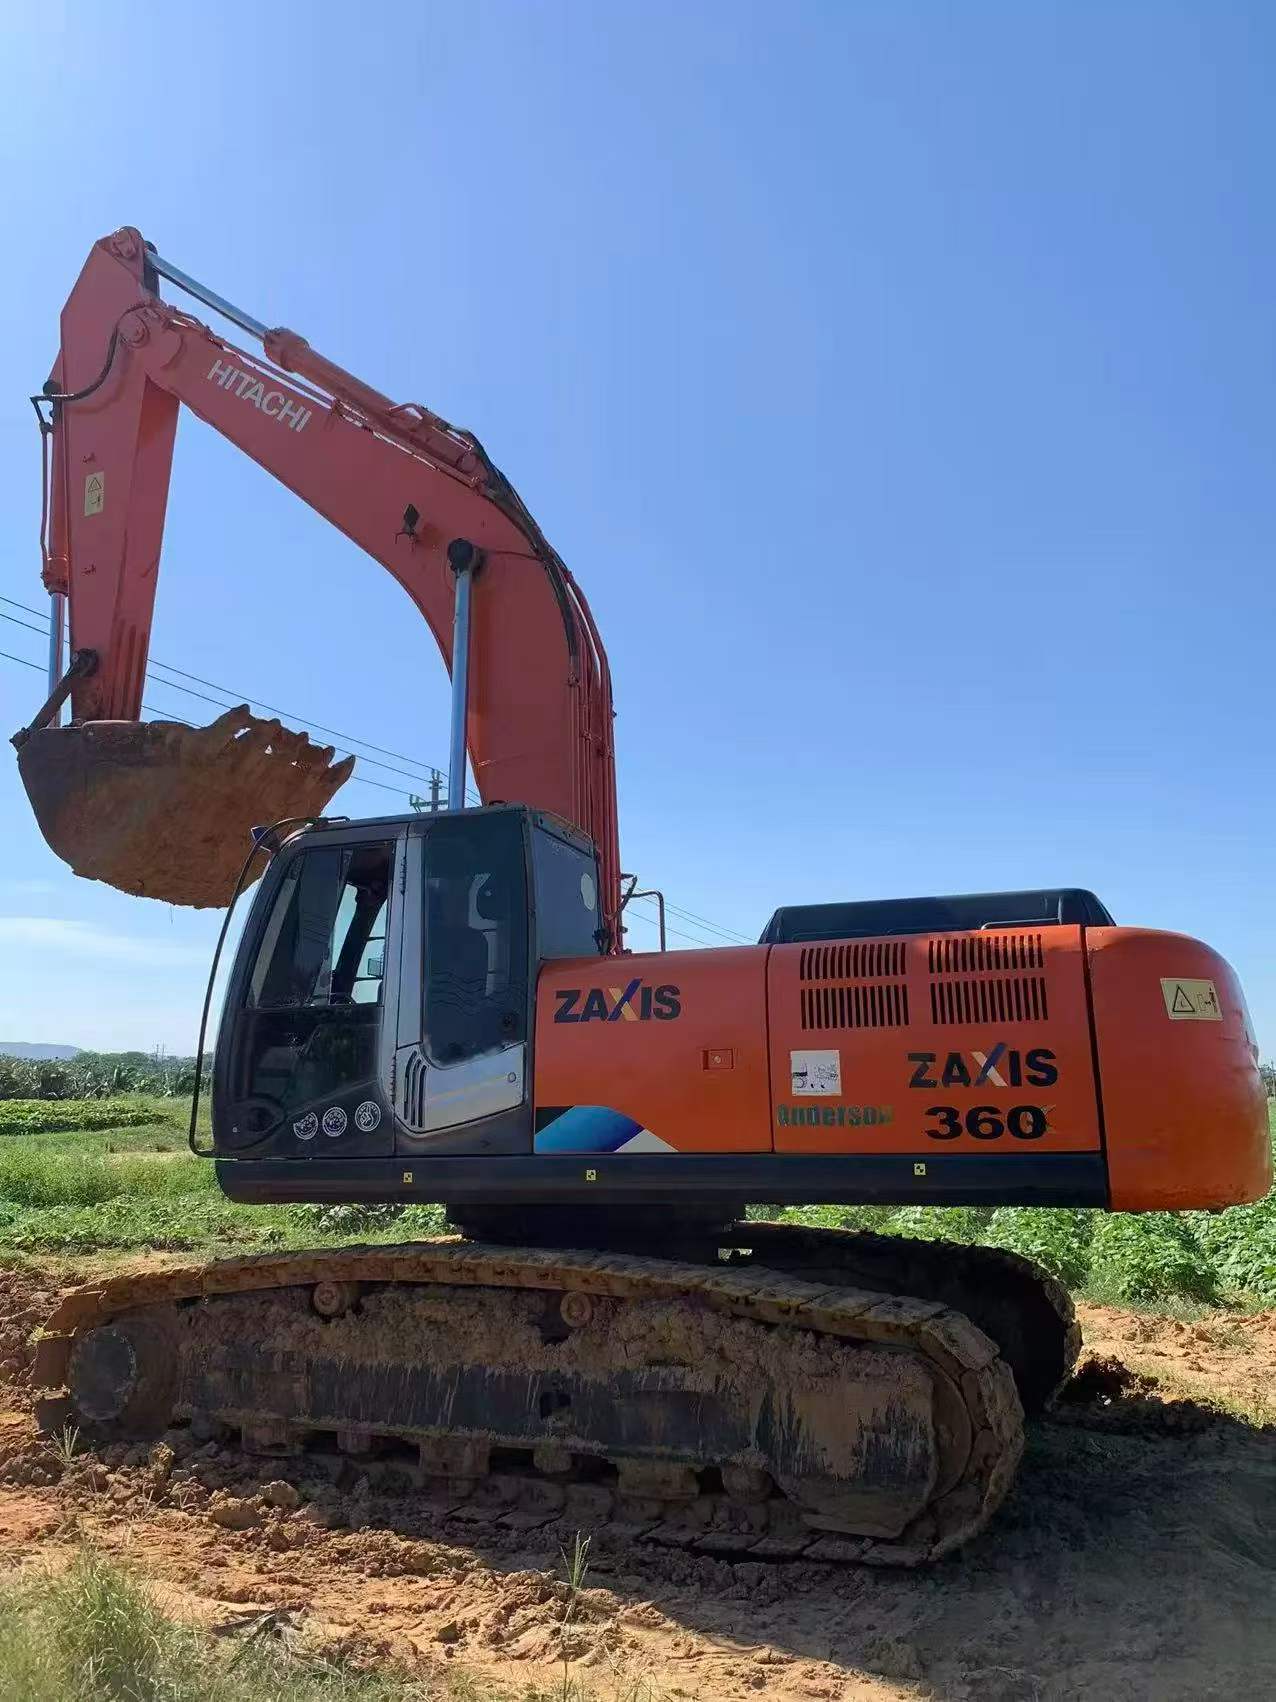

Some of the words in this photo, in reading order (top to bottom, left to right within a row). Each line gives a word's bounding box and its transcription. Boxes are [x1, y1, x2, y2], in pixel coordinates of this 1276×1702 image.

[207, 359, 312, 432] HITACHI
[554, 978, 681, 1023] ZAXIS
[907, 1043, 1058, 1088] ZAXIS
